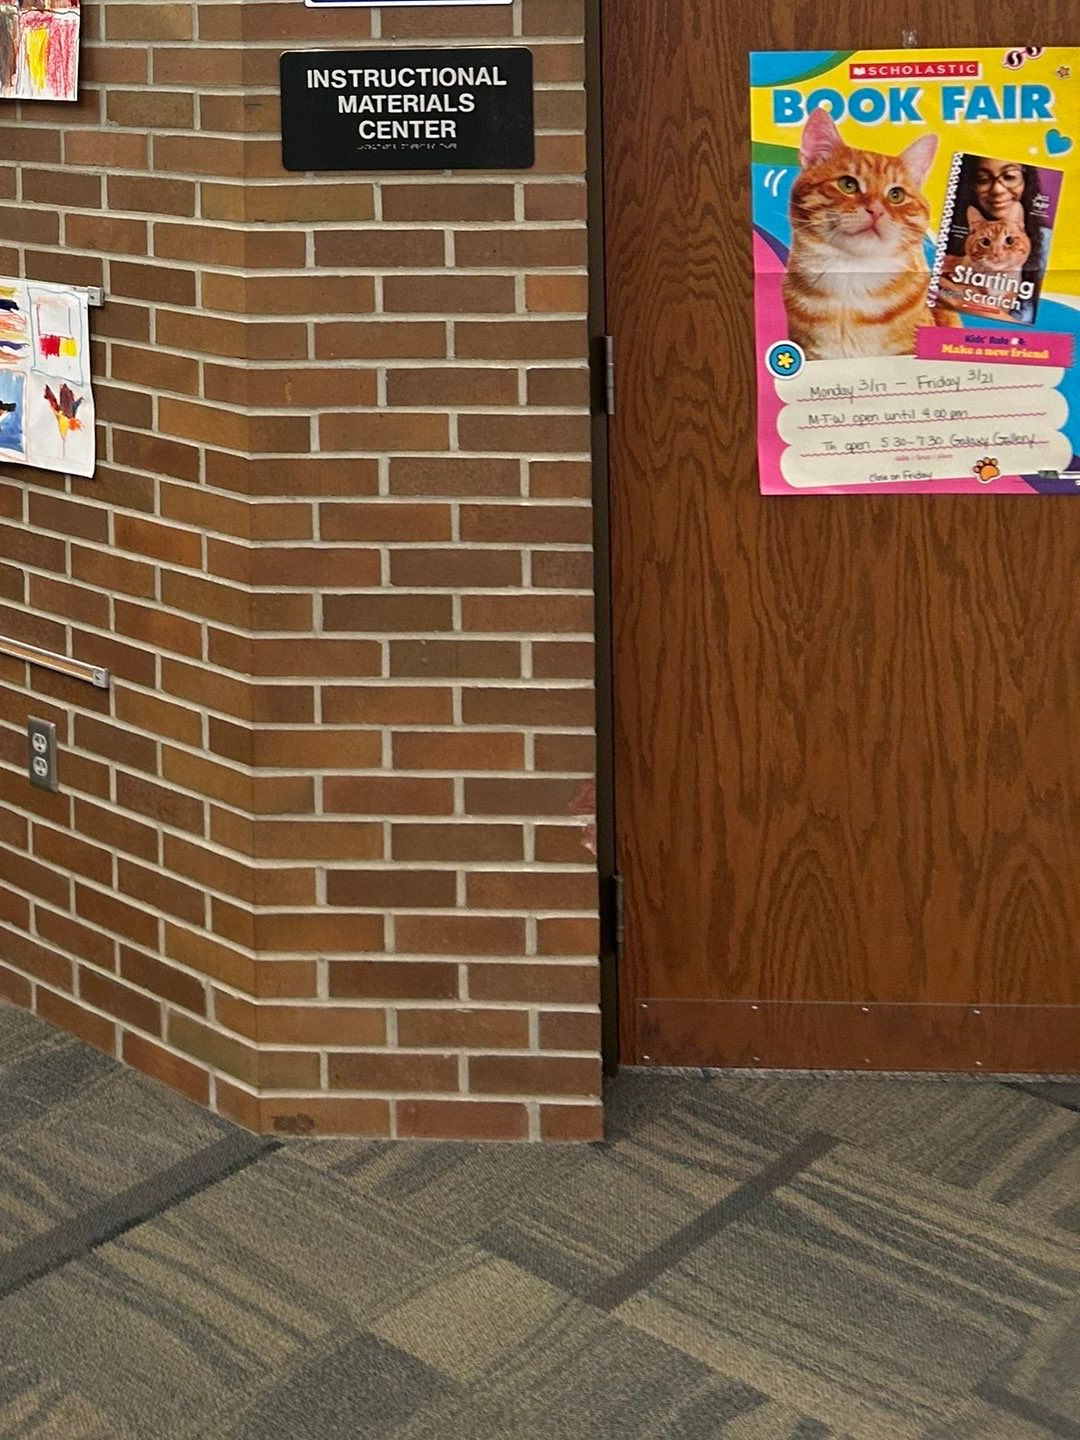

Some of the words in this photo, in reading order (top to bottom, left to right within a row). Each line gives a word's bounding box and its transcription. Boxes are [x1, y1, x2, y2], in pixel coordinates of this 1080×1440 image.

[306, 67, 507, 89] INSTRUCTIONAL
[867, 63, 976, 76] SCHOLASTIC
[337, 93, 476, 114] MATERIALS
[772, 87, 925, 124] BOOK
[940, 84, 1056, 122] FAIR
[358, 119, 457, 140] CENTER
[951, 264, 1035, 301] Starting
[963, 288, 1022, 311] Scratch
[941, 344, 974, 355] Make
[810, 383, 854, 404] Monday
[916, 375, 961, 392] Friday
[967, 369, 993, 384] 3/21
[852, 412, 879, 427] open
[884, 409, 916, 421] until
[845, 440, 870, 454] open
